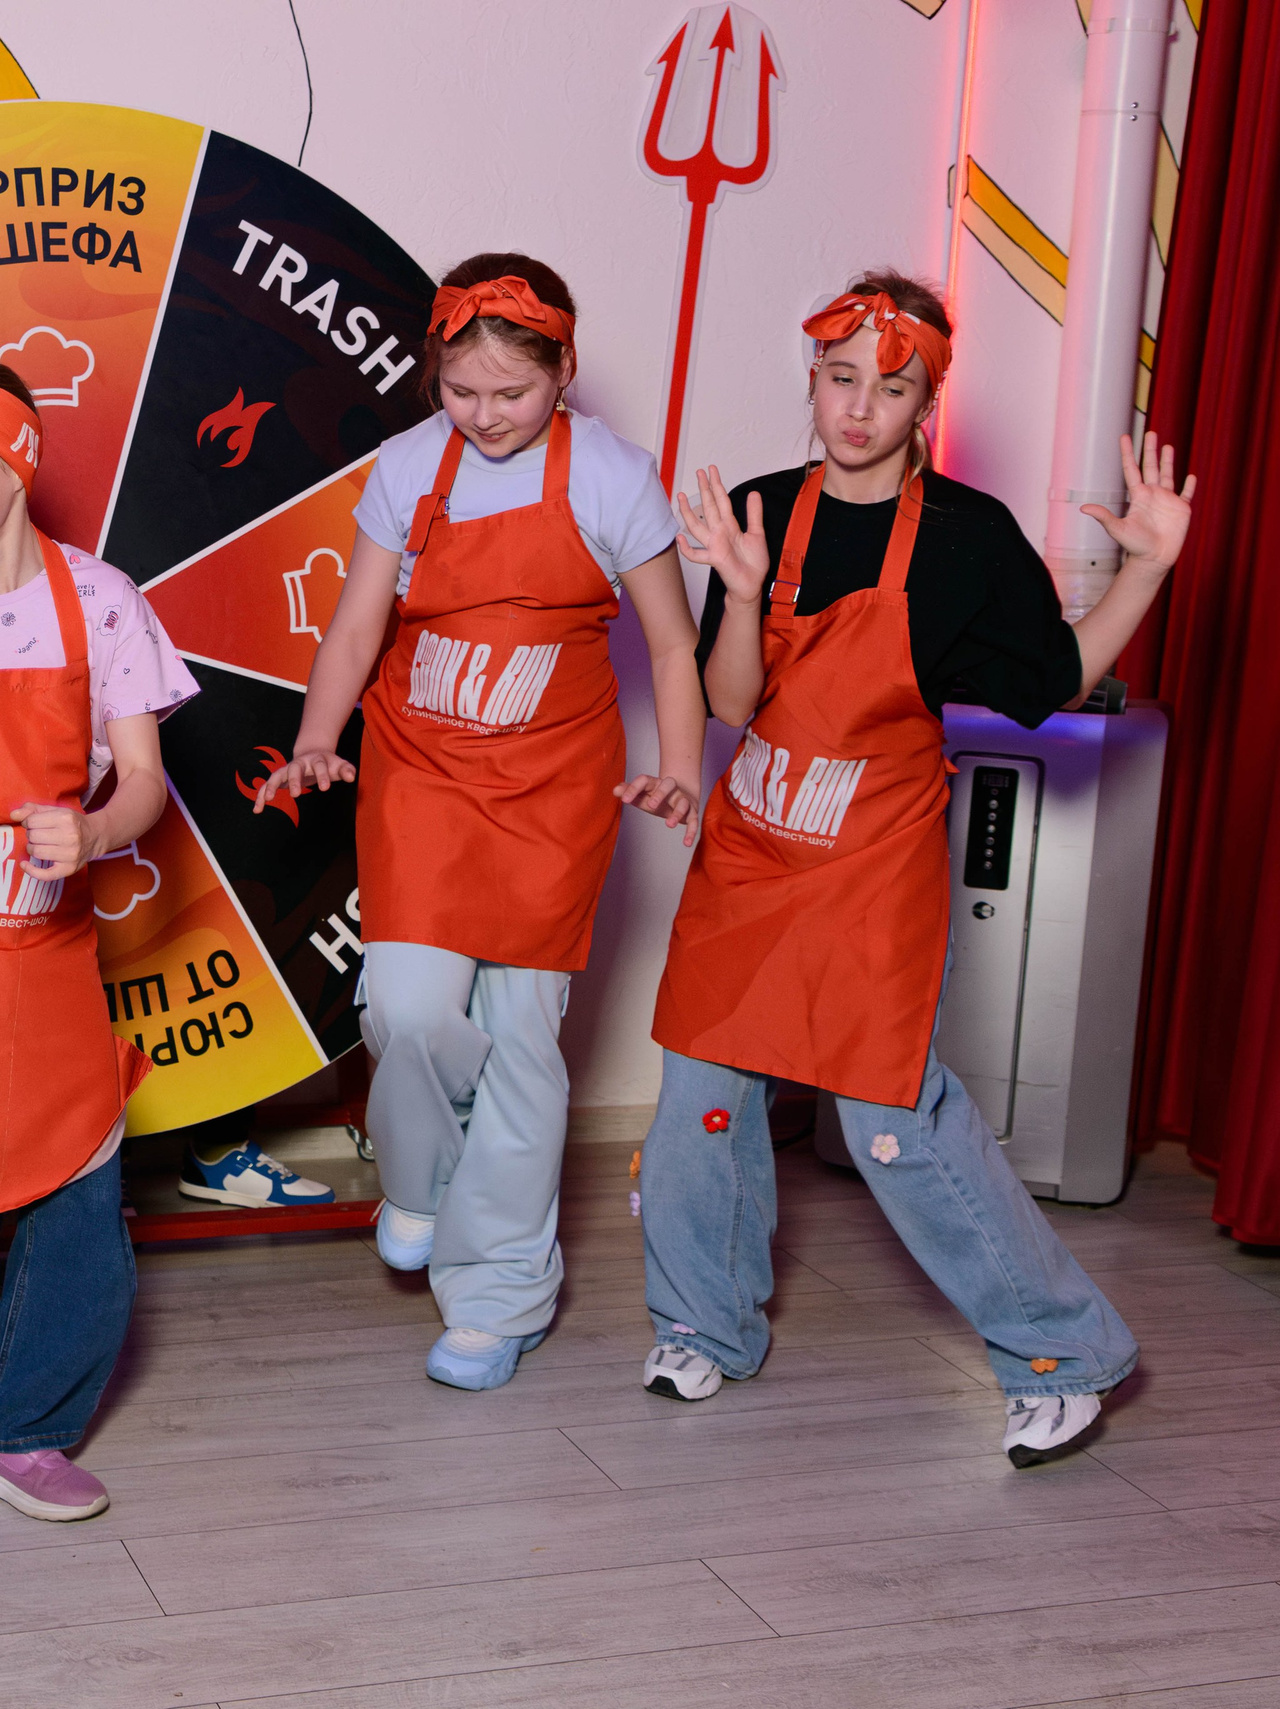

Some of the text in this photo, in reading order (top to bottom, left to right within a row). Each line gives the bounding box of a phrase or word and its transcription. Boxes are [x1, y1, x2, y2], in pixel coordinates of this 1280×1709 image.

[232, 219, 417, 396] TRASH
[407, 629, 563, 726] COOK & RUN
[401, 705, 527, 736] кулинарное квест-шоу
[764, 747, 790, 828] &
[784, 756, 868, 837] RUN
[769, 826, 836, 849] квест-шоу
[186, 950, 240, 1004] ОТ
